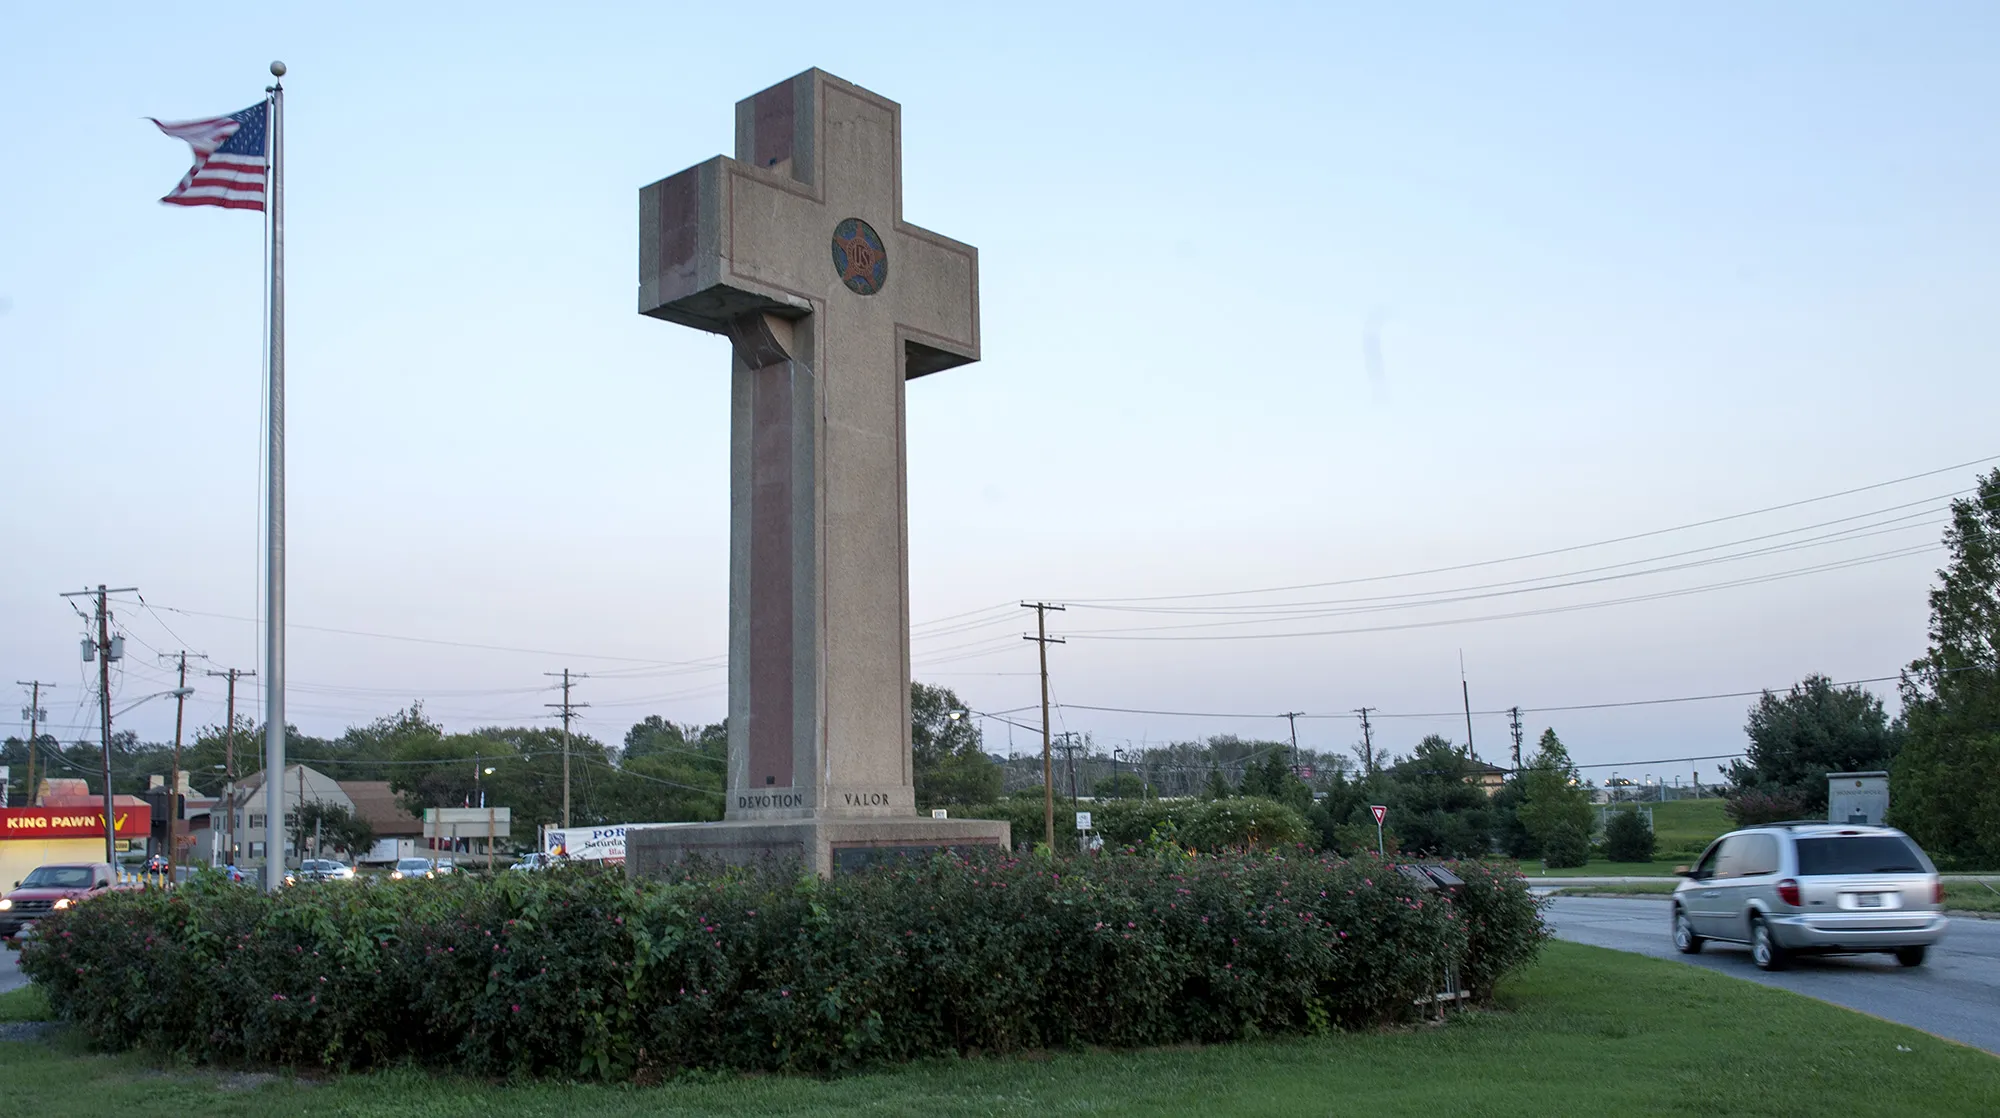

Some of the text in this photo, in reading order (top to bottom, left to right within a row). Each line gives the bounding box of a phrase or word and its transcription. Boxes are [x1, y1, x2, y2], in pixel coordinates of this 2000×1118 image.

[739, 794, 802, 809] DEVOTION
[845, 793, 889, 807] VALOR
[7, 815, 95, 828] KING PAWN
[593, 827, 635, 839] POR
